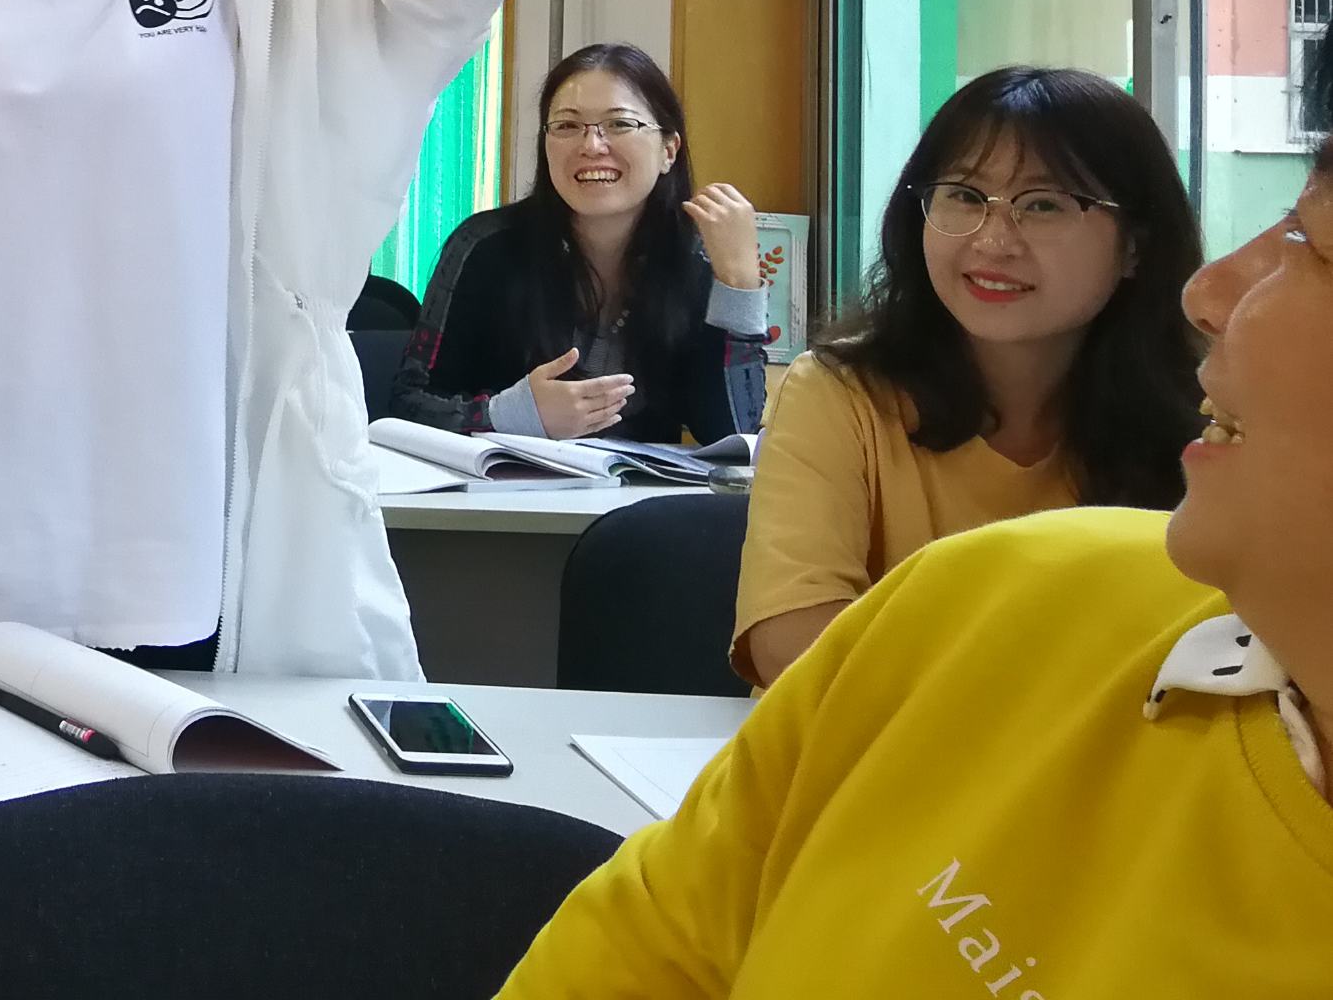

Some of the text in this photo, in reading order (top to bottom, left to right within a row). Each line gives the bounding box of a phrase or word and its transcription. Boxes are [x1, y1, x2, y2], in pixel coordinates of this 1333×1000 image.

[138, 31, 155, 40] YOU
[156, 27, 174, 36] ARE
[174, 24, 194, 35] VERY
[916, 857, 1045, 1000] Mai
